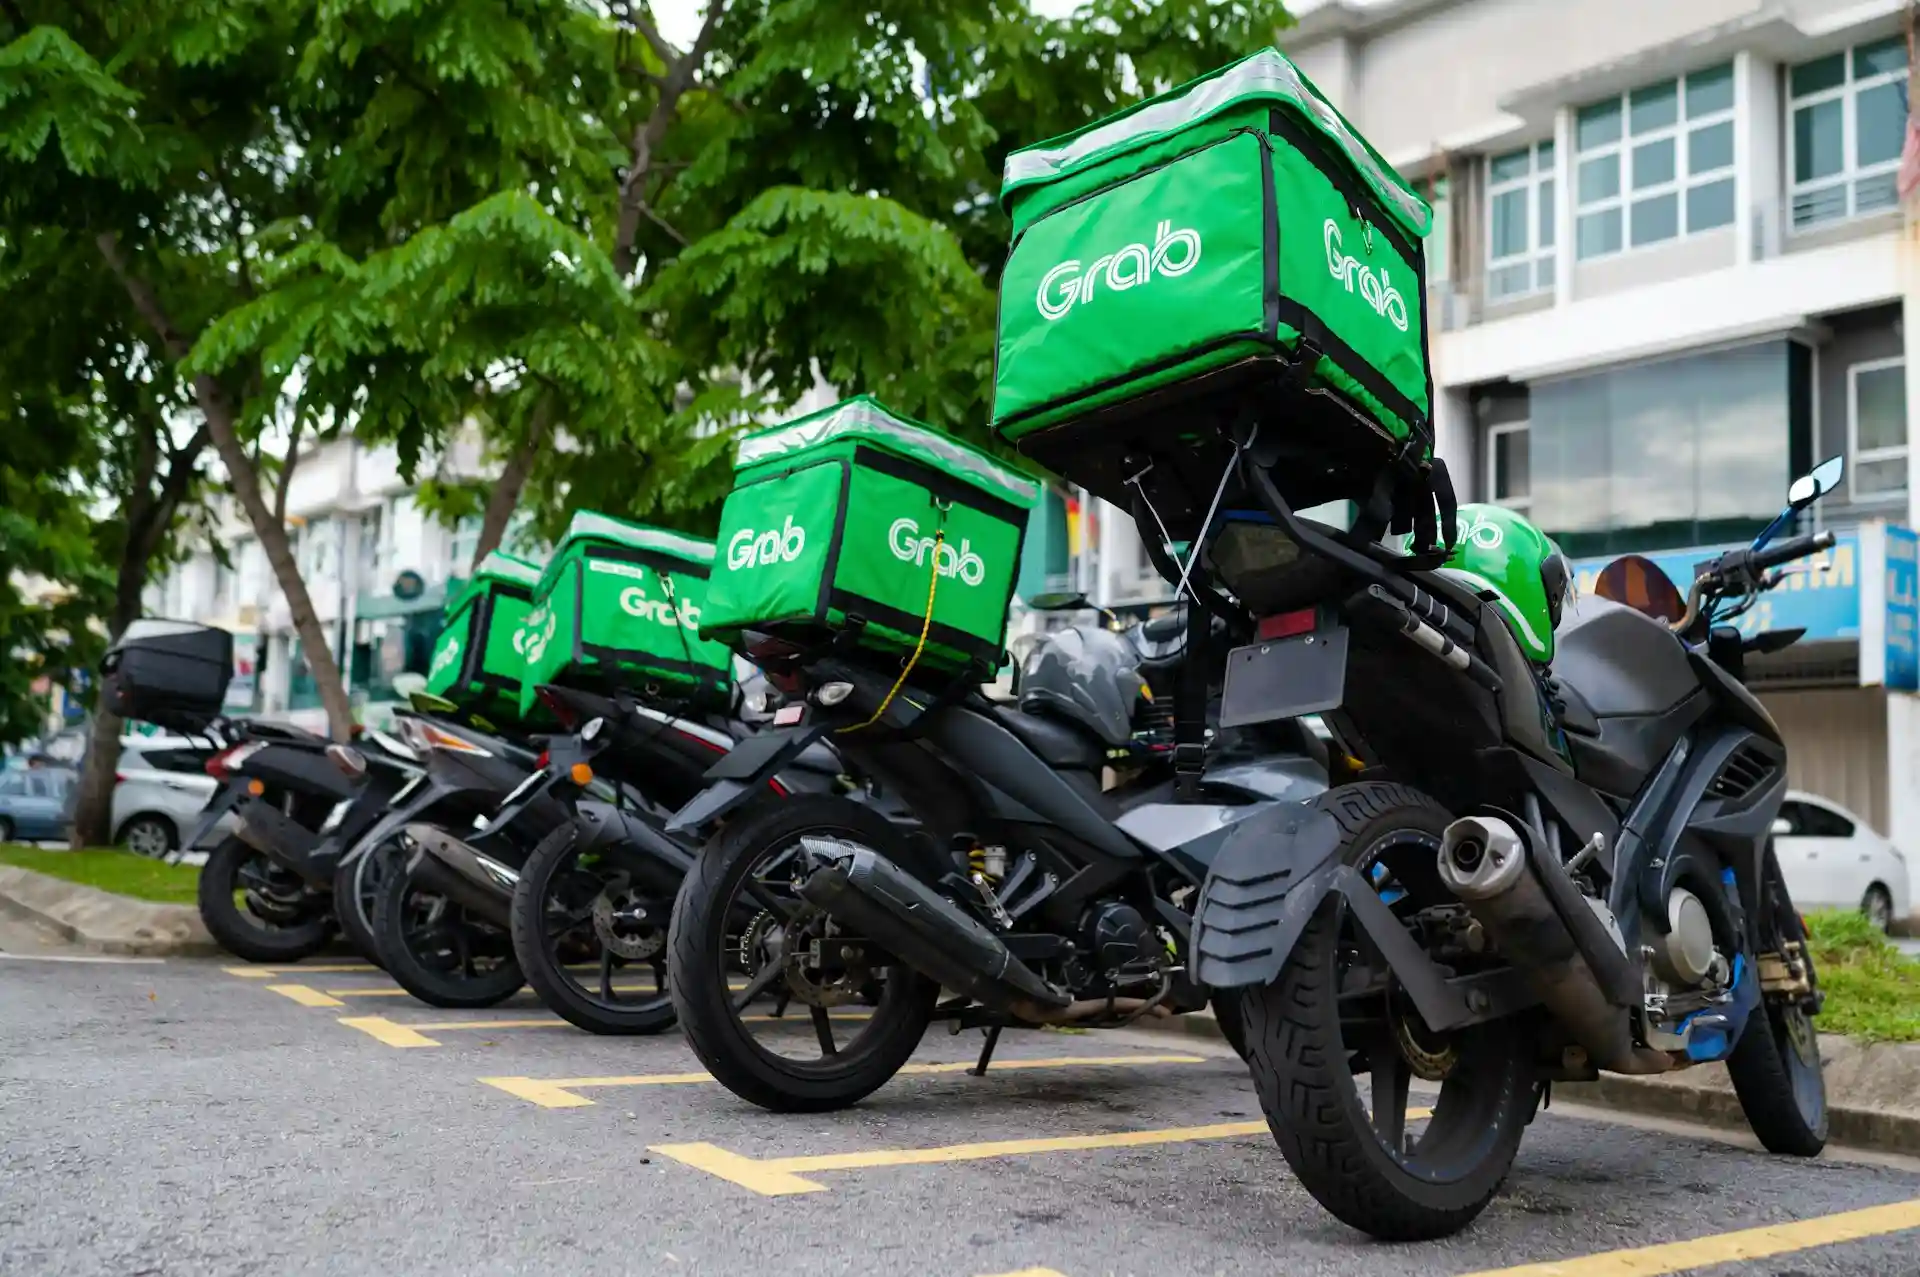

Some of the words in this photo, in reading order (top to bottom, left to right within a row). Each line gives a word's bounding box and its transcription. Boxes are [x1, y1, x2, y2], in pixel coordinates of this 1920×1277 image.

[1036, 219, 1201, 320] Grab
[1322, 218, 1409, 332] Grab
[727, 515, 805, 571] Grab
[888, 518, 985, 586] Grab
[619, 586, 702, 631] Grab
